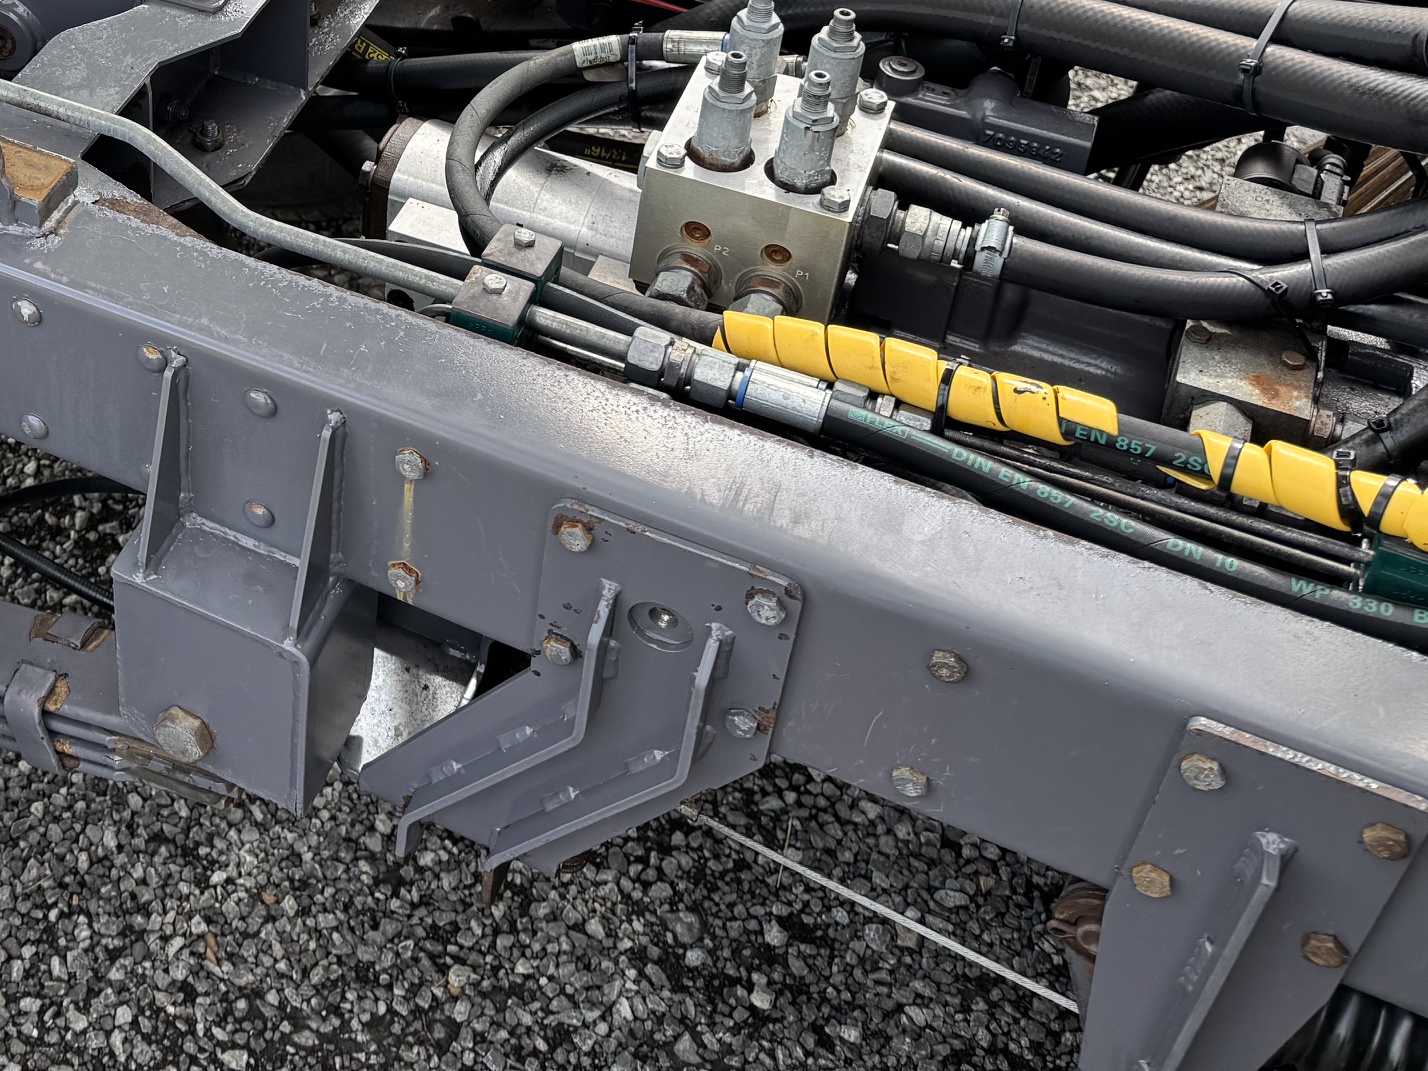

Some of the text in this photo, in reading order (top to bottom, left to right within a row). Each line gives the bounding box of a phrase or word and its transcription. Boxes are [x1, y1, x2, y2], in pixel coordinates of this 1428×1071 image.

[584, 145, 628, 161] 13/16"
[714, 244, 730, 256] P2
[795, 269, 809, 280] P1
[1074, 424, 1107, 445] EN
[1115, 436, 1157, 458] 857
[951, 447, 992, 474] DIN
[998, 467, 1031, 491] EN
[1036, 485, 1077, 509] 857
[1089, 509, 1134, 534] 2SC
[1165, 535, 1202, 561] DN
[1213, 553, 1239, 573] 10
[1290, 577, 1332, 600] WP
[1348, 593, 1395, 617] 330
